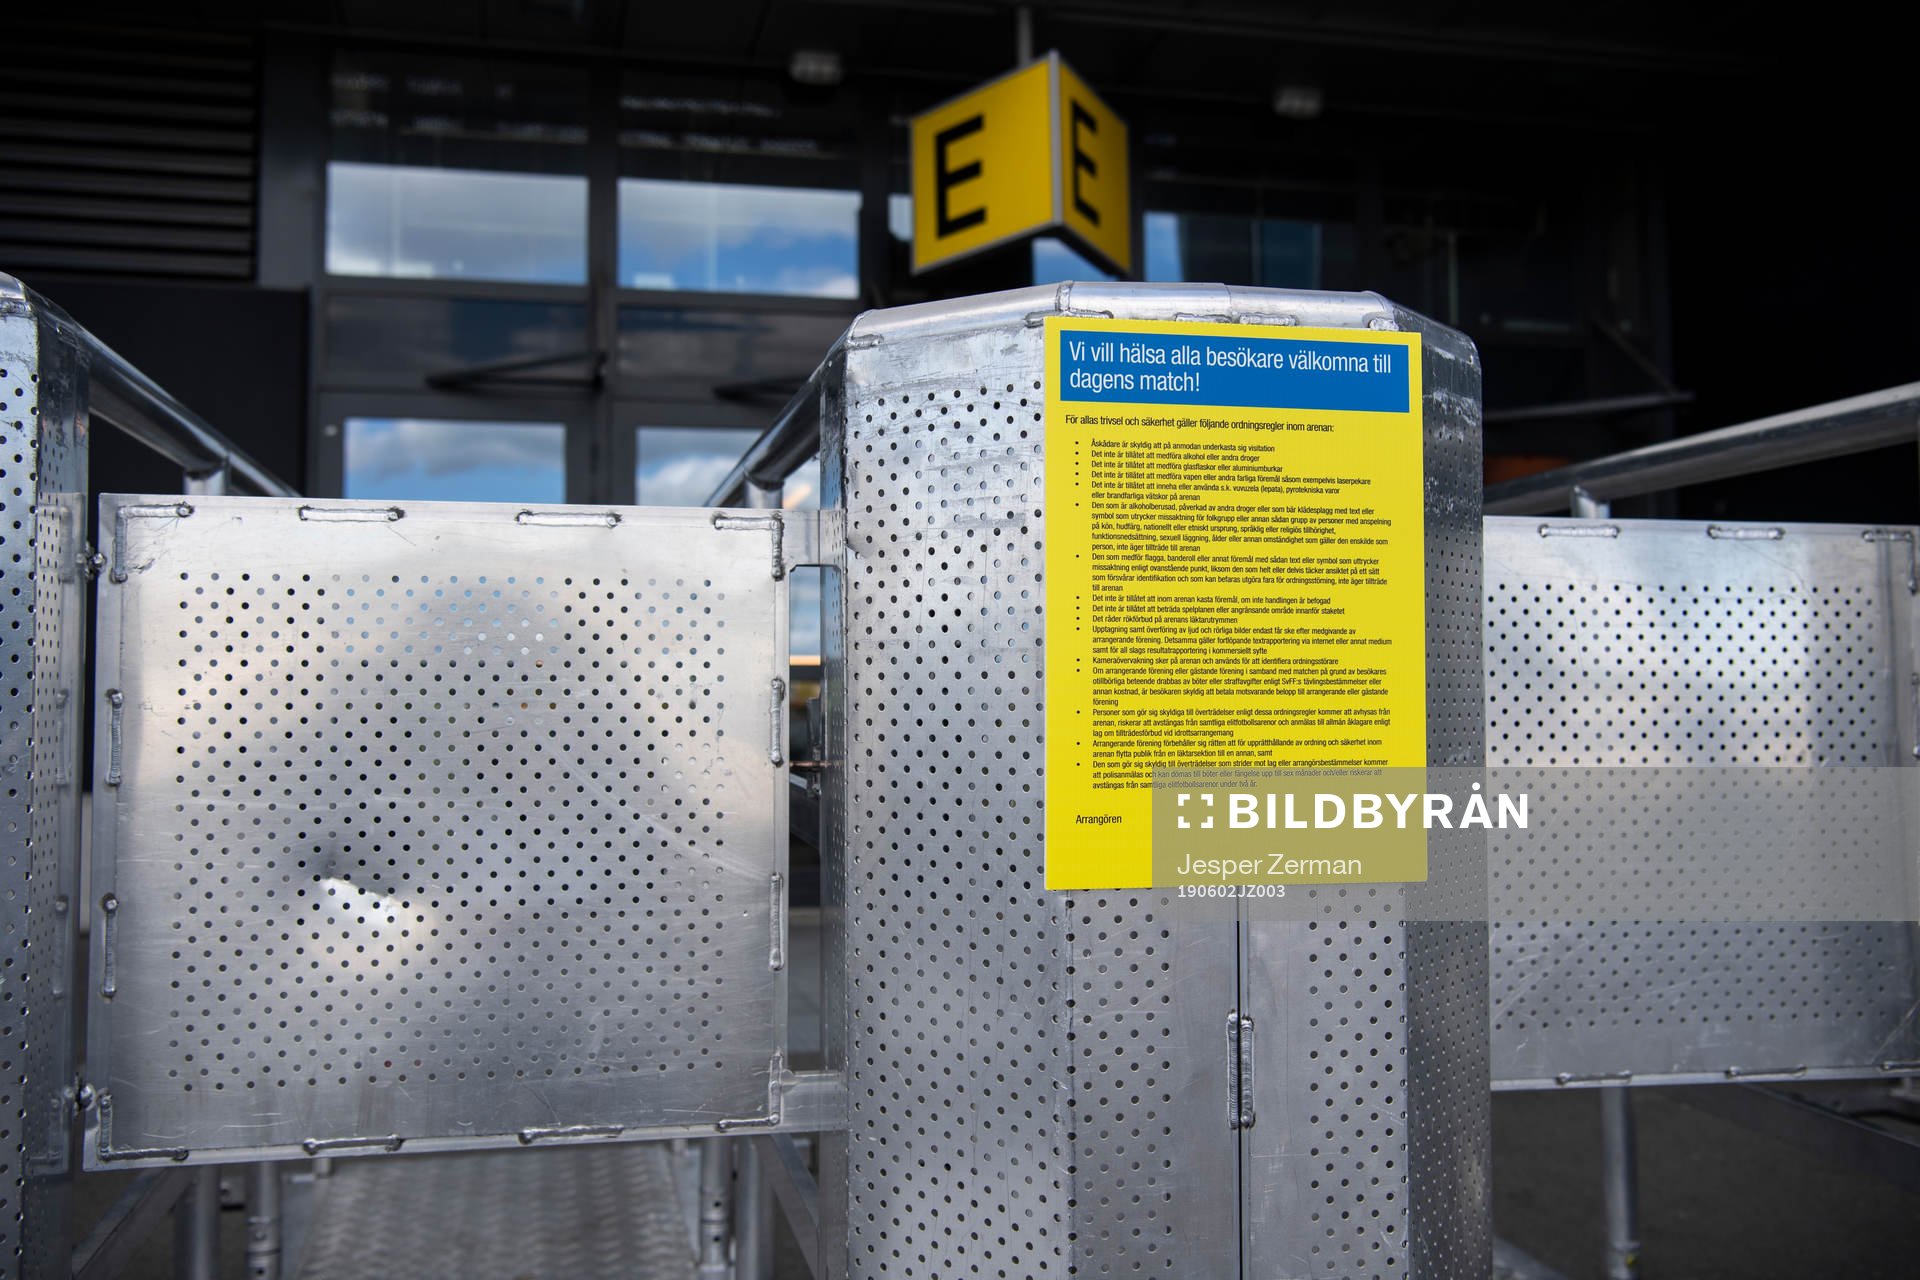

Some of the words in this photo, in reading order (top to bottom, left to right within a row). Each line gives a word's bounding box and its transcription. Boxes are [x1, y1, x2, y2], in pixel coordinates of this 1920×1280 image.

[1071, 99, 1101, 228] E
[935, 112, 986, 241] E
[1069, 341, 1085, 361] Vi
[1091, 342, 1114, 362] vill
[1120, 343, 1166, 364] hälsa
[1171, 345, 1201, 366] alla
[1206, 346, 1284, 369] besökare
[1288, 350, 1369, 373] välkomna
[1373, 354, 1391, 373] till
[1070, 368, 1134, 392] dagens
[1140, 371, 1199, 392] match!
[1065, 414, 1079, 424] För
[1080, 415, 1099, 425] allas
[1100, 415, 1124, 425] trivsel
[1125, 416, 1140, 426] och
[1141, 417, 1175, 427] säkerhet
[1176, 418, 1198, 429] gäller
[1199, 418, 1230, 430] följande
[1230, 419, 1285, 431] ordningsregler
[1286, 421, 1305, 431] inom
[1306, 423, 1334, 432] arenan:
[1091, 438, 1121, 448] Åskådare
[1129, 441, 1152, 450] skyldig
[1163, 442, 1172, 450] på
[1172, 442, 1202, 450] anmodan
[1202, 443, 1237, 451] underkasta
[1237, 444, 1247, 452] sig
[1248, 444, 1275, 452] visitation
[1091, 460, 1103, 468] Det
[1125, 461, 1145, 469] tillåtet
[1156, 462, 1182, 470] medföra
[1183, 463, 1217, 472] glasflaskor
[1231, 464, 1283, 472] aluminiumburkar
[1117, 471, 1124, 479] är
[1155, 472, 1182, 480] medföra
[1183, 474, 1203, 482] vapen
[1203, 473, 1217, 481] eller
[1236, 474, 1257, 483] farliga
[1281, 475, 1302, 483] såsom
[1302, 476, 1336, 485] exempelvis
[1336, 477, 1371, 486] laserpekare
[1091, 491, 1105, 499] eller
[1106, 492, 1145, 501] brandfarliga
[1145, 492, 1169, 500] vätskor
[1169, 493, 1178, 501] på
[1129, 543, 1144, 552] äger
[1104, 615, 1122, 623] råder
[1122, 615, 1154, 623] rökförbud
[1154, 616, 1163, 624] på
[1189, 616, 1238, 625] läktarutrymmen
[1092, 625, 1129, 634] Upptagning
[1146, 626, 1178, 634] överföring
[1187, 626, 1200, 635] ljud
[1200, 626, 1213, 634] och
[1213, 626, 1233, 635] rörliga
[1311, 627, 1348, 636] medgivande
[1092, 657, 1154, 665] Kameraövervakning
[1170, 657, 1179, 665] på
[1292, 657, 1339, 666] ordningsstörare
[1093, 698, 1119, 707] förening
[1136, 708, 1148, 717] gör
[1148, 708, 1159, 717] sig
[1159, 708, 1185, 717] skyldiga
[1186, 708, 1194, 716] till
[1195, 708, 1235, 716] överträdelser
[1236, 708, 1254, 717] enligt
[1273, 708, 1317, 717] ordningsregler
[1353, 708, 1378, 716] avhysas
[1092, 729, 1103, 738] lag
[1174, 729, 1234, 737] idrottsarrangemang
[1115, 750, 1132, 759] flytta
[1133, 750, 1153, 758] publik
[1093, 760, 1106, 768] Den
[1121, 760, 1133, 769] gör
[1133, 760, 1144, 769] sig
[1144, 760, 1167, 768] skyldig
[1233, 759, 1253, 767] strider
[1267, 759, 1277, 767] lag
[1292, 759, 1362, 767] arrangörsbestämmelser
[1363, 758, 1388, 766] kommer
[1076, 814, 1122, 826] Arrangören
